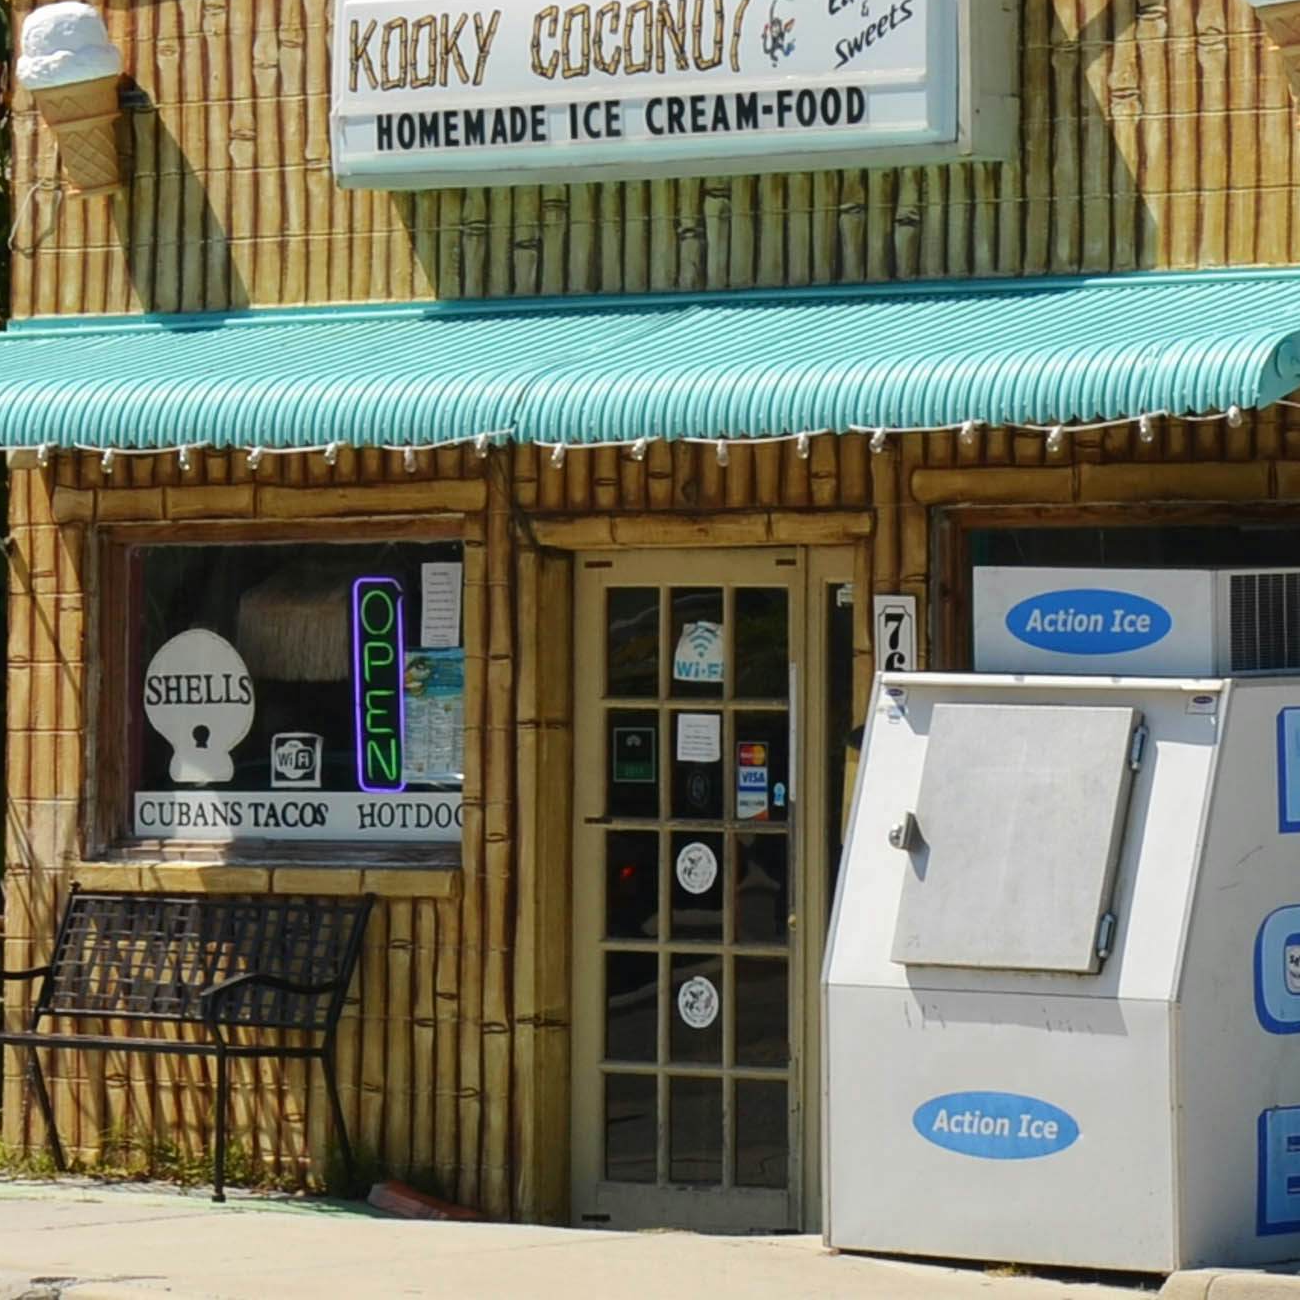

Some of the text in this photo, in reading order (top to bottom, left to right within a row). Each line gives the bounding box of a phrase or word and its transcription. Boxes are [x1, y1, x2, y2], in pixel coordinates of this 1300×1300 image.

[348, 9, 502, 93] KOOKY
[375, 85, 866, 152] HOMEMADE ICE CREAM-FOOD
[1024, 607, 1151, 634] Action Ice
[146, 673, 251, 706] SHELLS
[360, 589, 399, 782] OPEN
[138, 800, 243, 828] CUBANS
[249, 801, 330, 828] TACOS
[931, 1107, 1060, 1140] Action Ice
